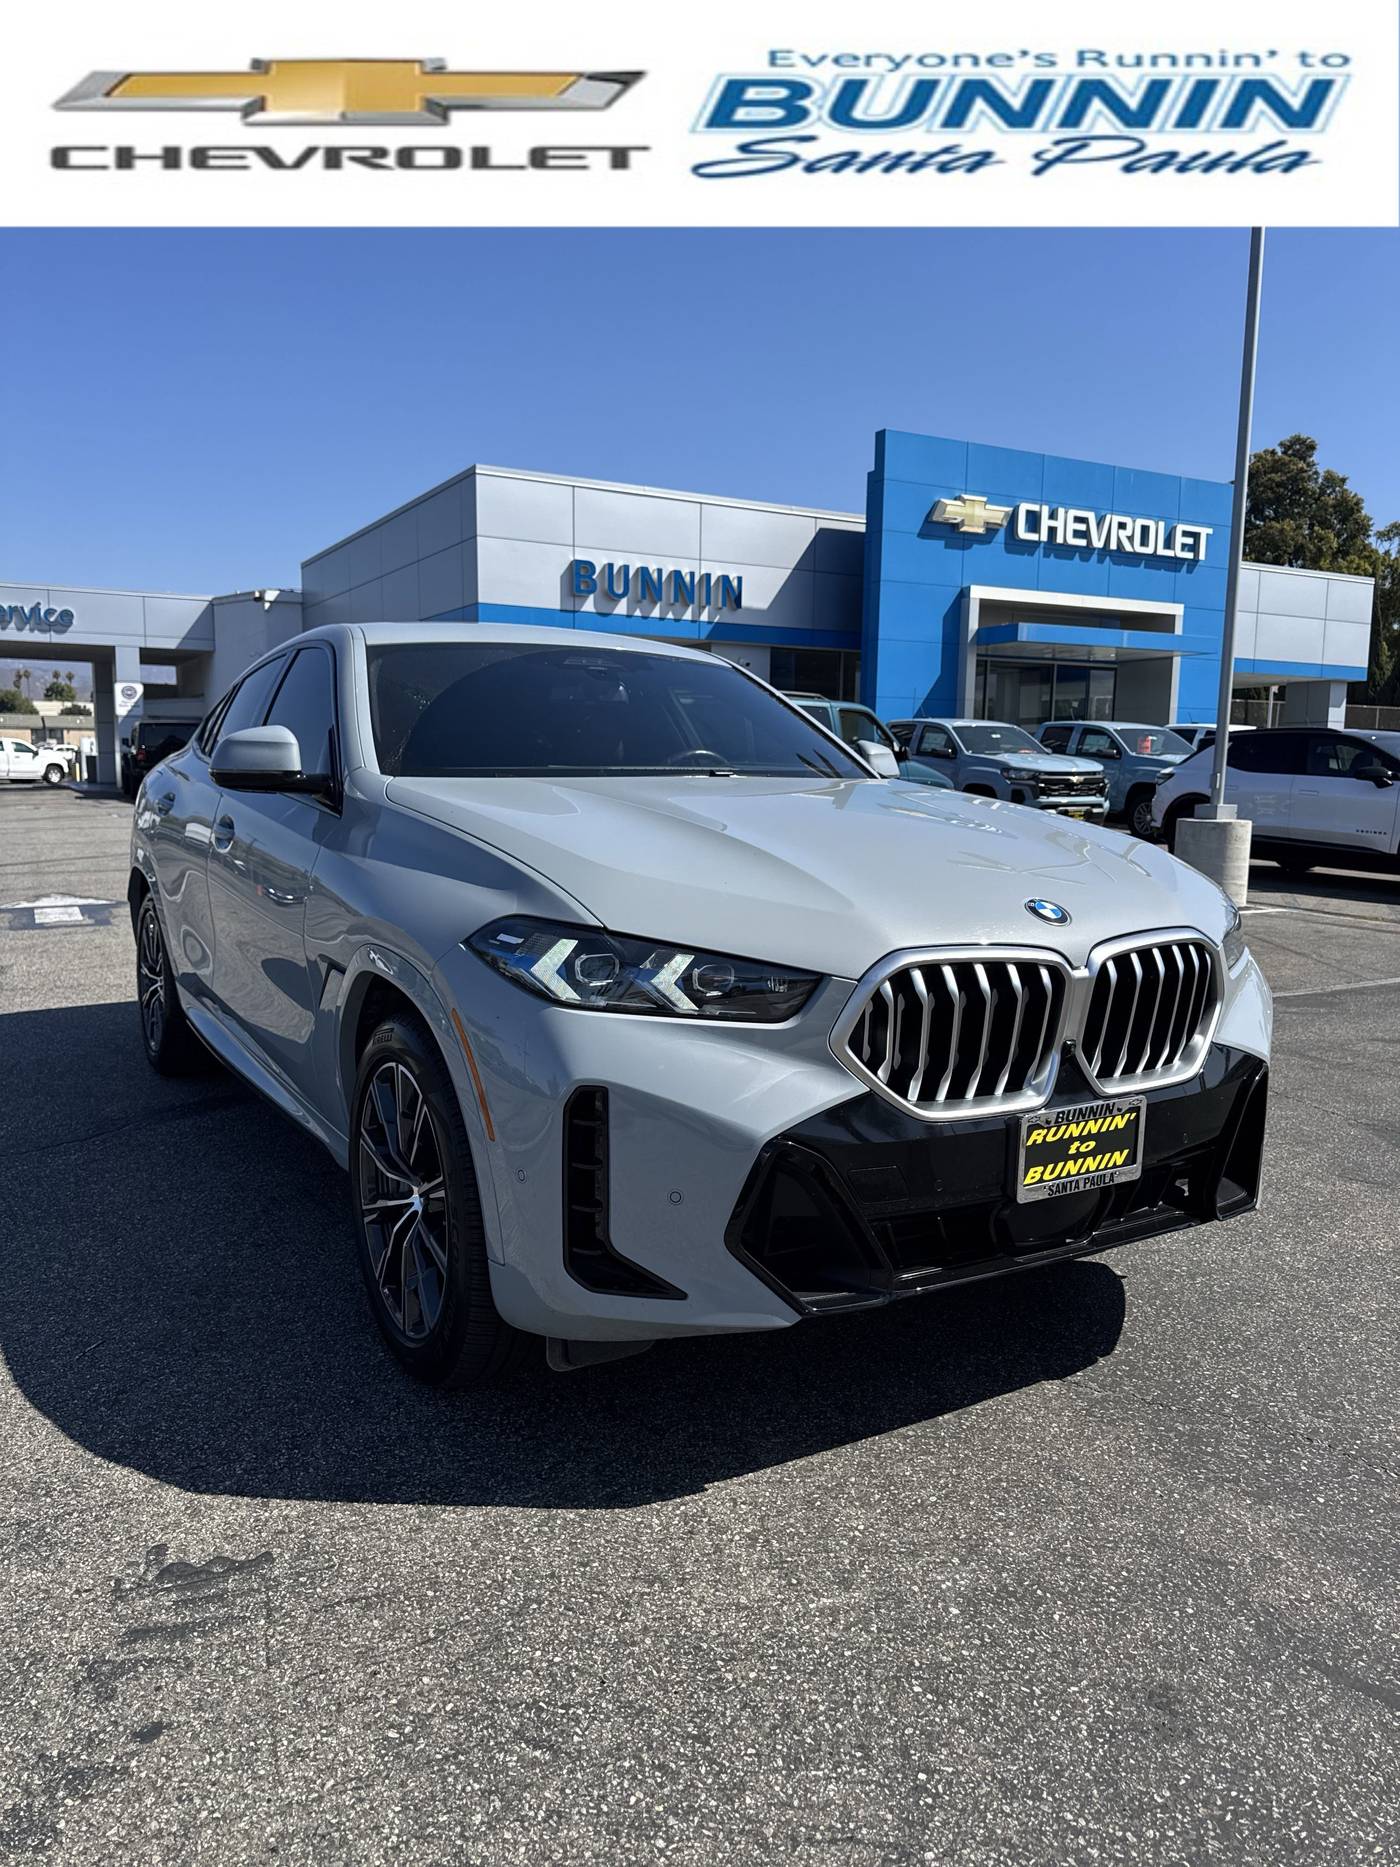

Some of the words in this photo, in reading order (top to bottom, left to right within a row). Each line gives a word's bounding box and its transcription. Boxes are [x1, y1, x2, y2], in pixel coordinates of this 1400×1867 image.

[1016, 502, 1214, 561] CHEVROLET
[572, 558, 743, 610] BUNNIN
[1026, 1112, 1137, 1146] RUNNIN'
[1054, 1102, 1116, 1125] BUNNIN
[1068, 1140, 1097, 1155] to
[1023, 1149, 1130, 1185] BUNNIN
[1047, 1179, 1080, 1197] SANTA
[1083, 1172, 1116, 1189] PAULA
